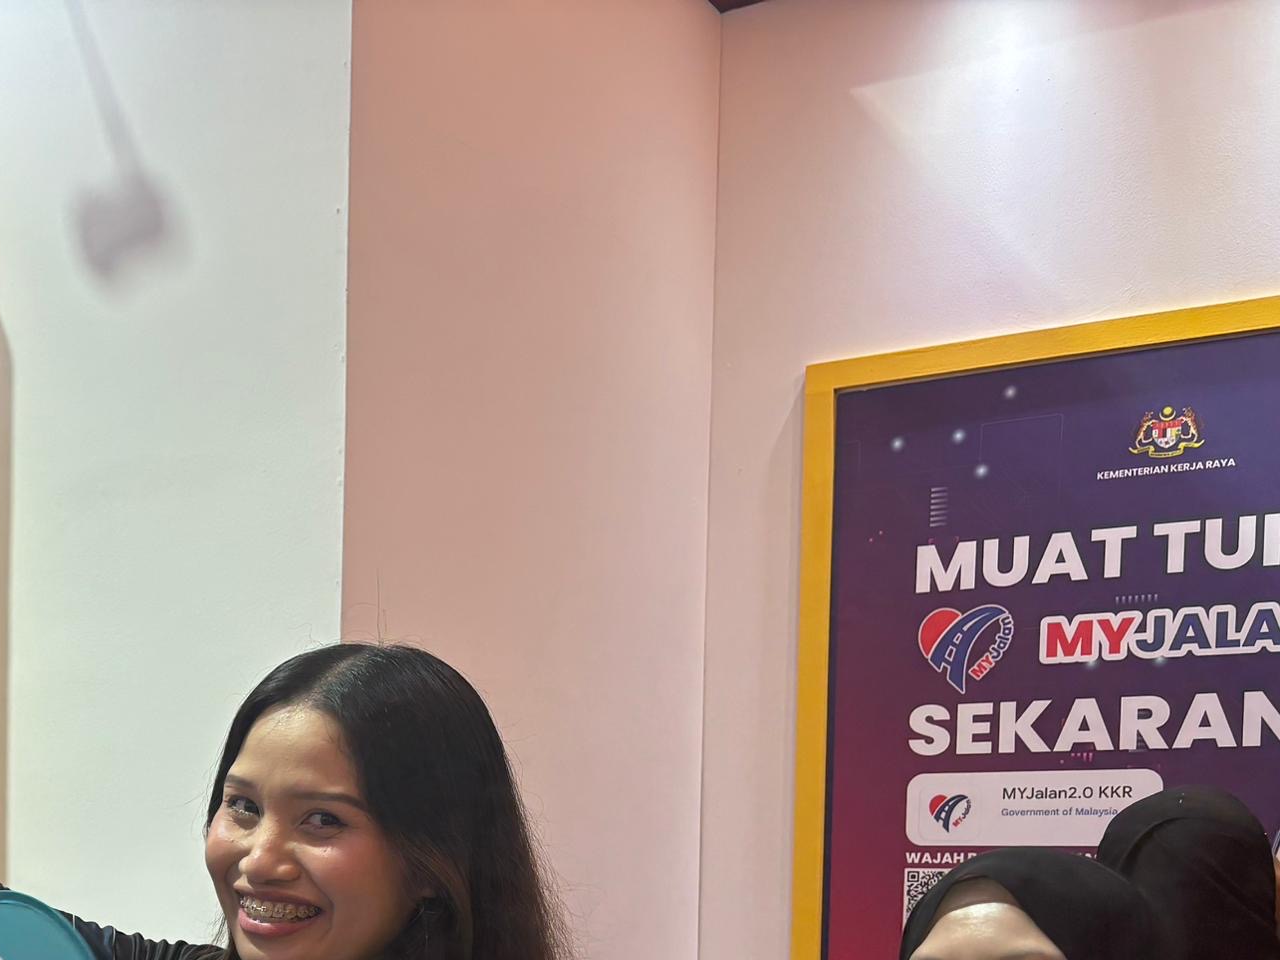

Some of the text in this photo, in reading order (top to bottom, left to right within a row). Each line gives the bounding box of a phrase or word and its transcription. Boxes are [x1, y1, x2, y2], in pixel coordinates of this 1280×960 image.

[1097, 458, 1236, 480] KEMENTERIAN KERJA RAYA
[915, 526, 1138, 594] MUAT
[1002, 785, 1133, 800] MYJalan2.0 KKR
[1001, 807, 1118, 818] Government of Malaysia
[906, 852, 965, 864] WAJAH
